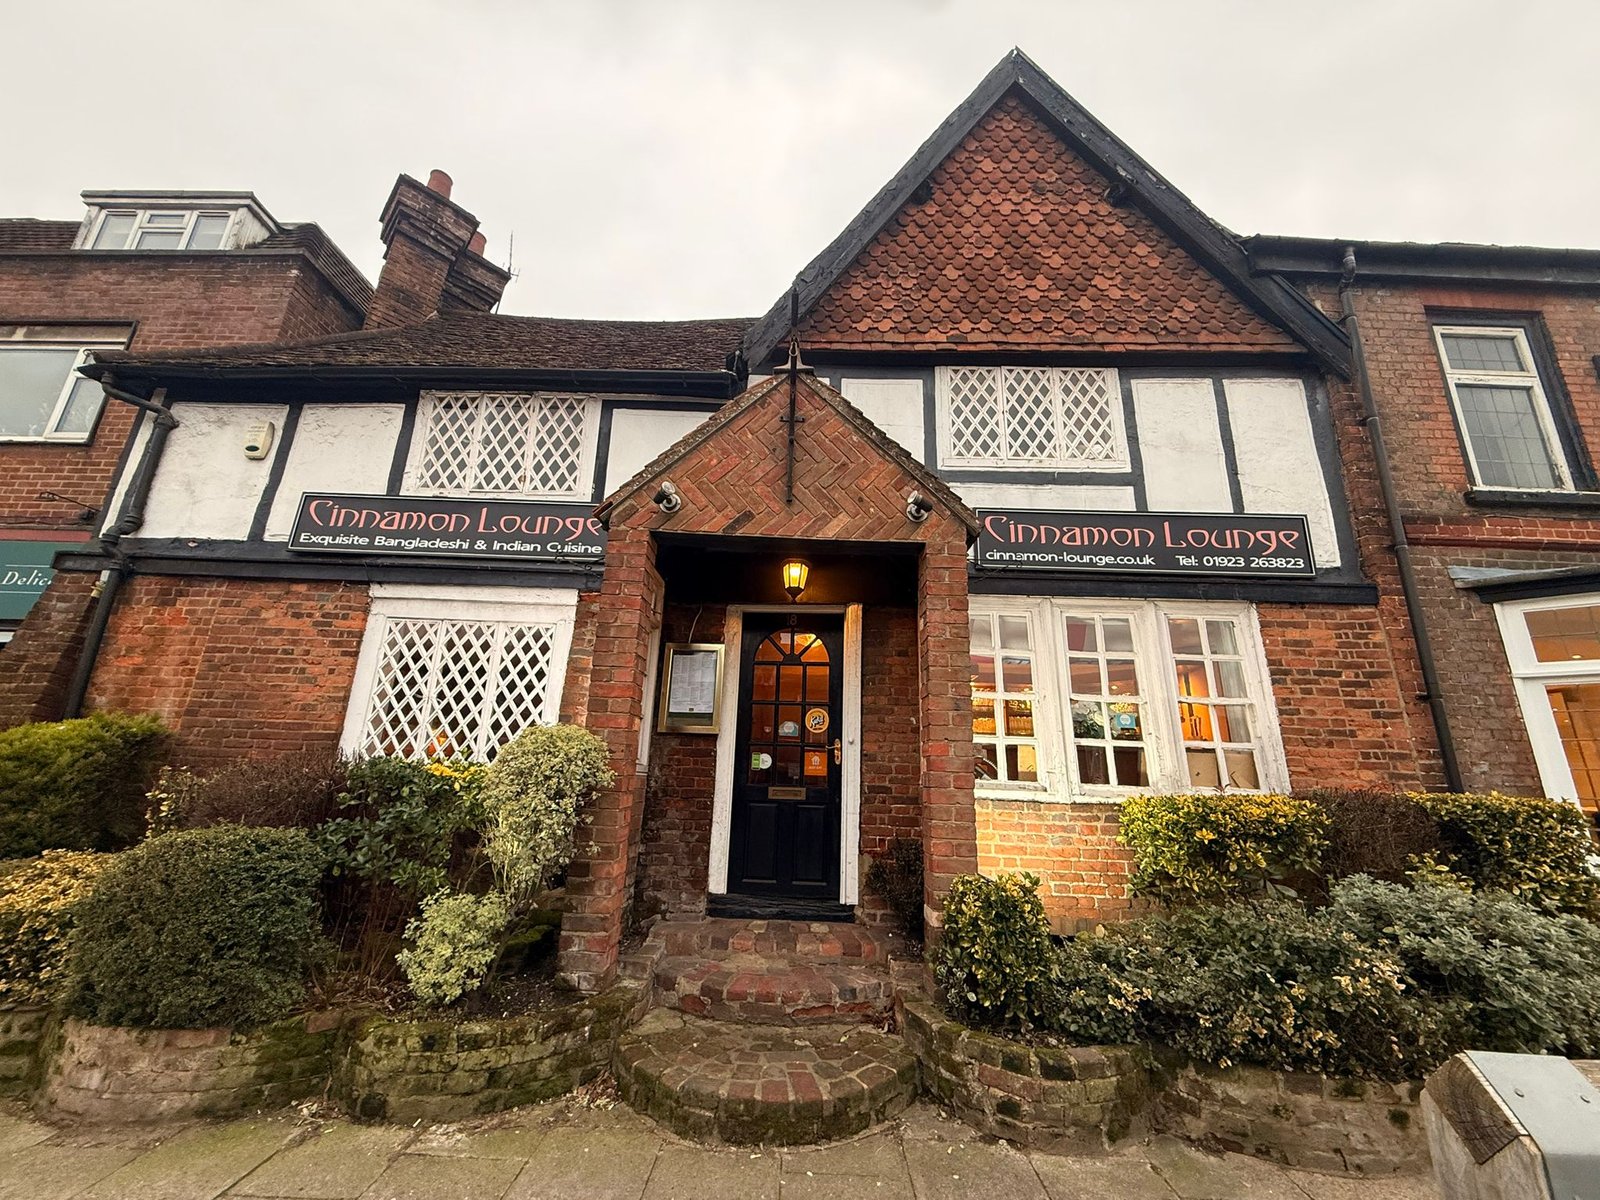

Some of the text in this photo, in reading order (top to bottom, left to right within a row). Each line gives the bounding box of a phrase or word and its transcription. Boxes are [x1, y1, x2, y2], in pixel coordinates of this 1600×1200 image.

[308, 499, 603, 542] Cinnamon Lounge
[299, 532, 603, 554] Exquisite Bangladeshi & Indian Cuisine
[984, 515, 1300, 555] Cinnamon Lounge
[985, 549, 1156, 566] cinnamon-lounge.co.uk
[1176, 555, 1304, 569] Tel: 01923 263823
